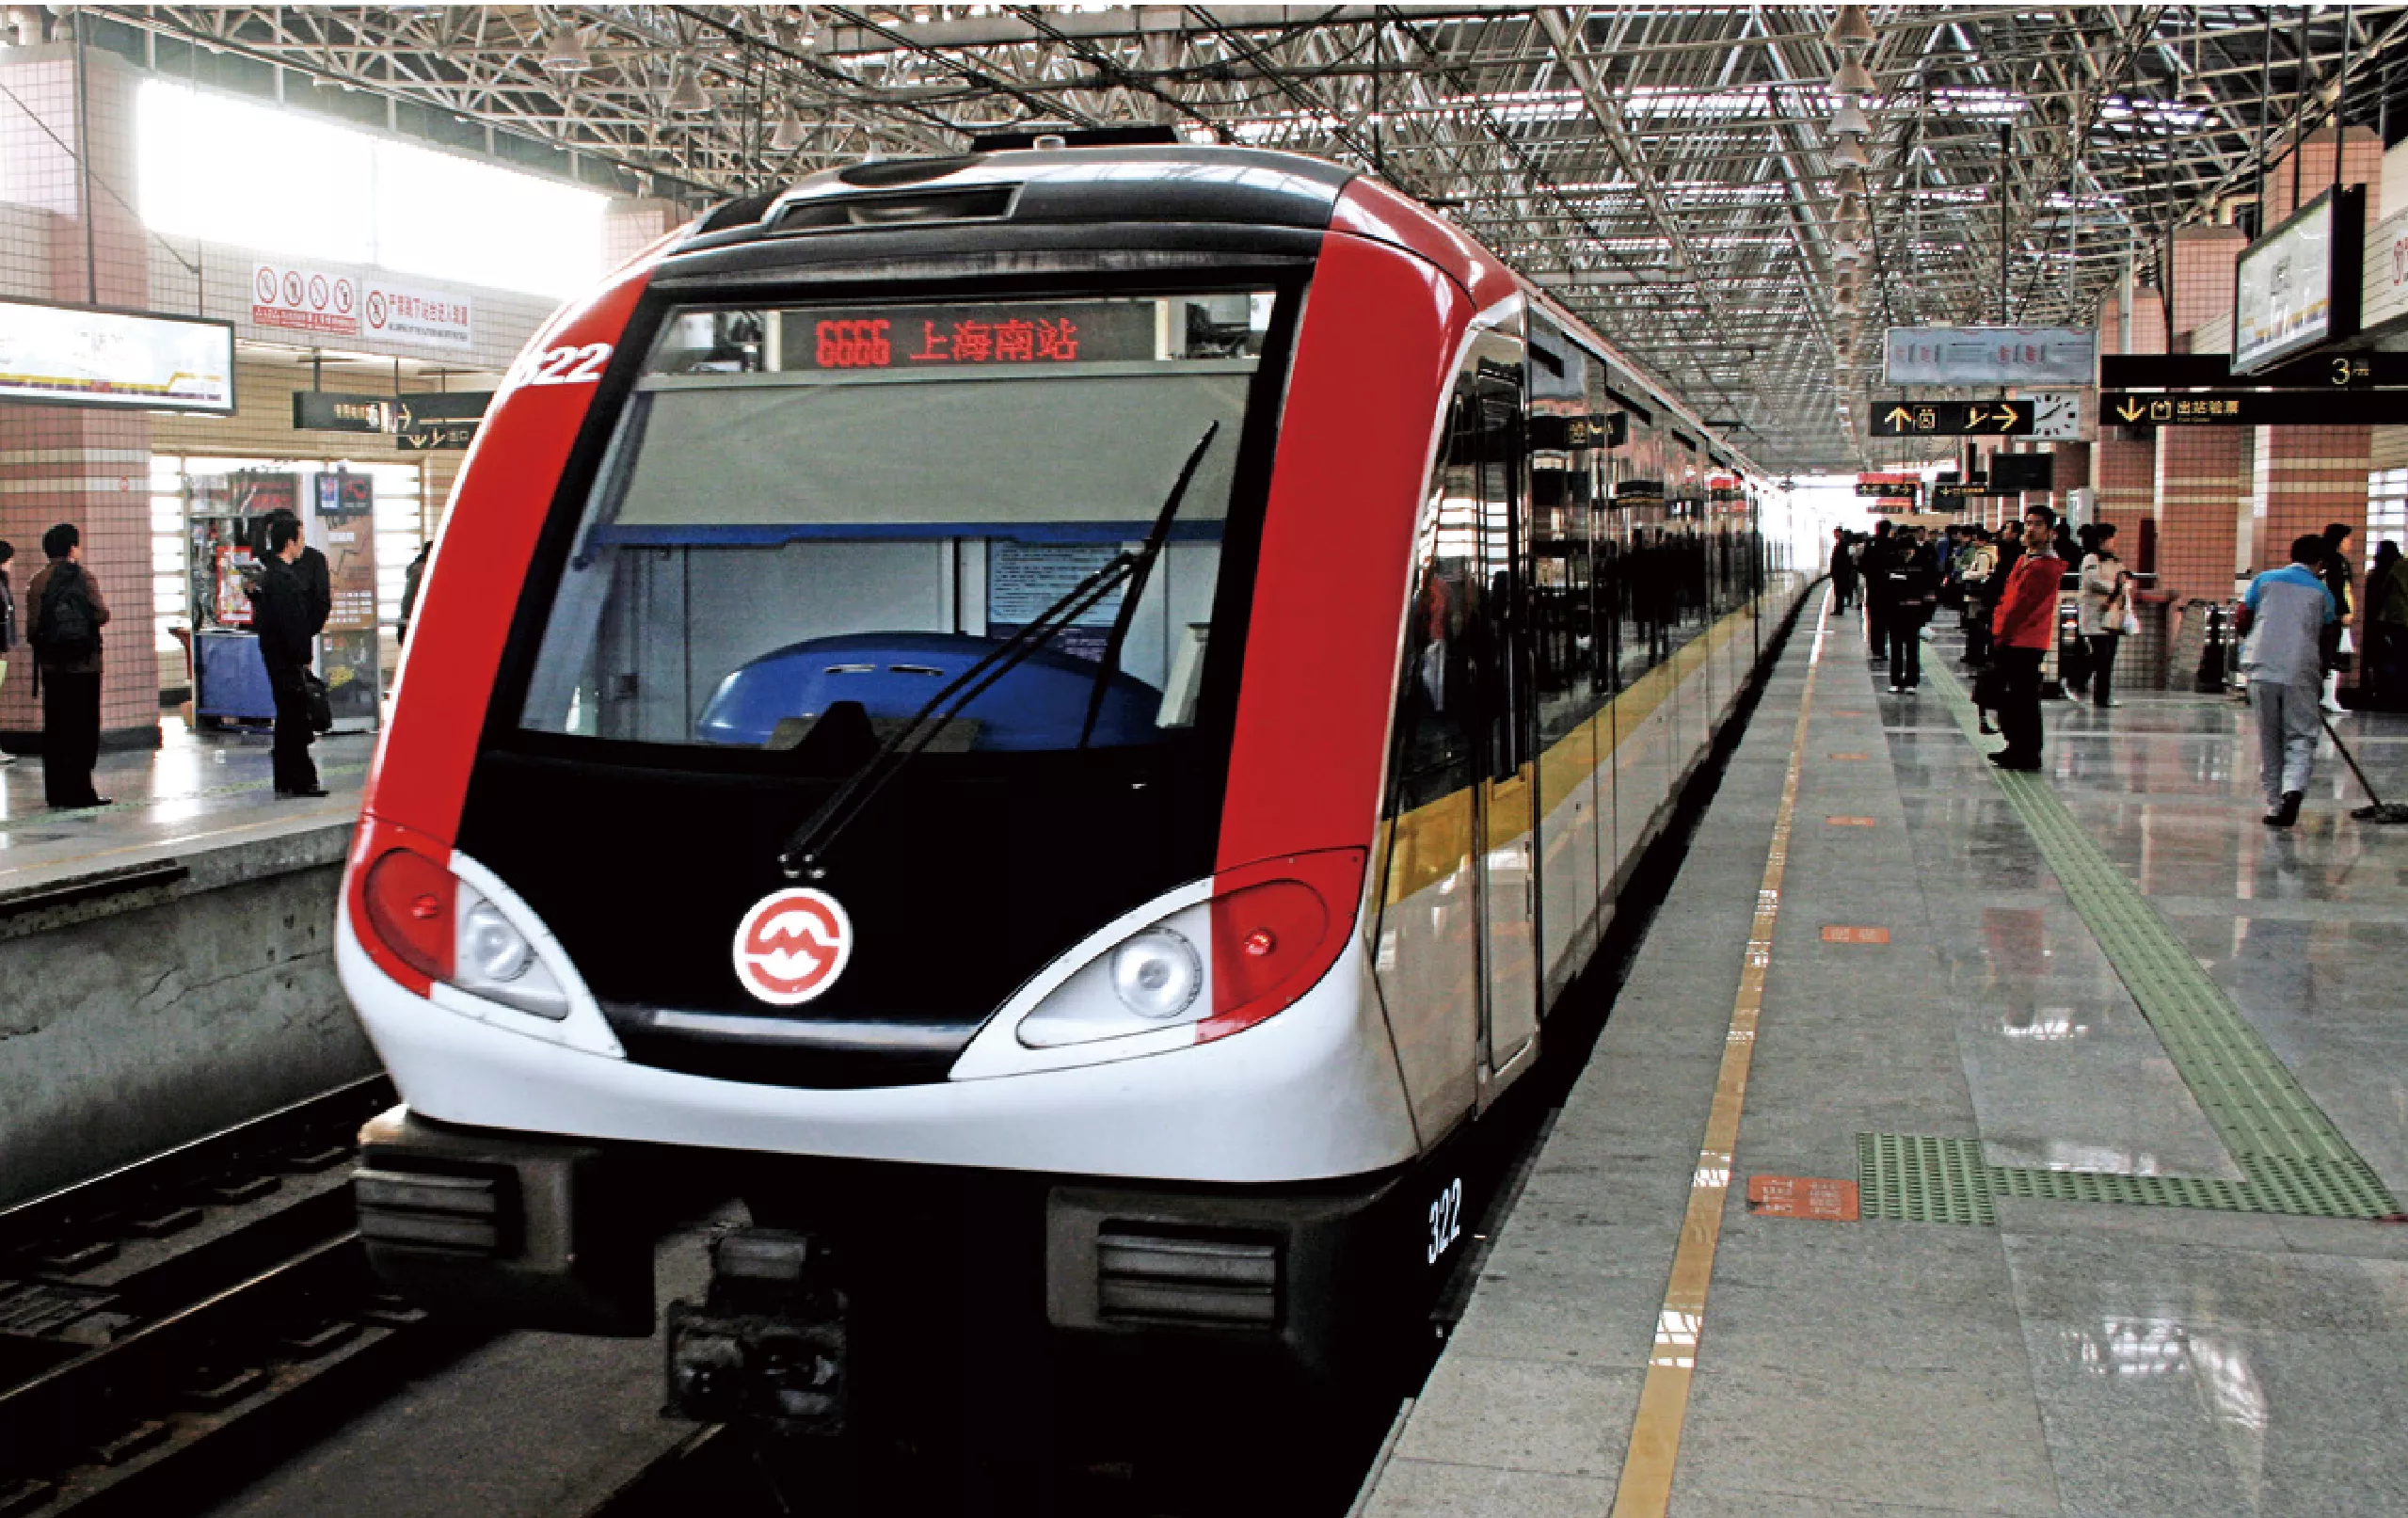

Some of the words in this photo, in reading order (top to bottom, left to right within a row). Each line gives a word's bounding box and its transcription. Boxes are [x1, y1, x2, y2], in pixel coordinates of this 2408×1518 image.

[910, 317, 1079, 361] 上海南站
[2331, 358, 2351, 385] 3
[1427, 1177, 1462, 1265] 322
